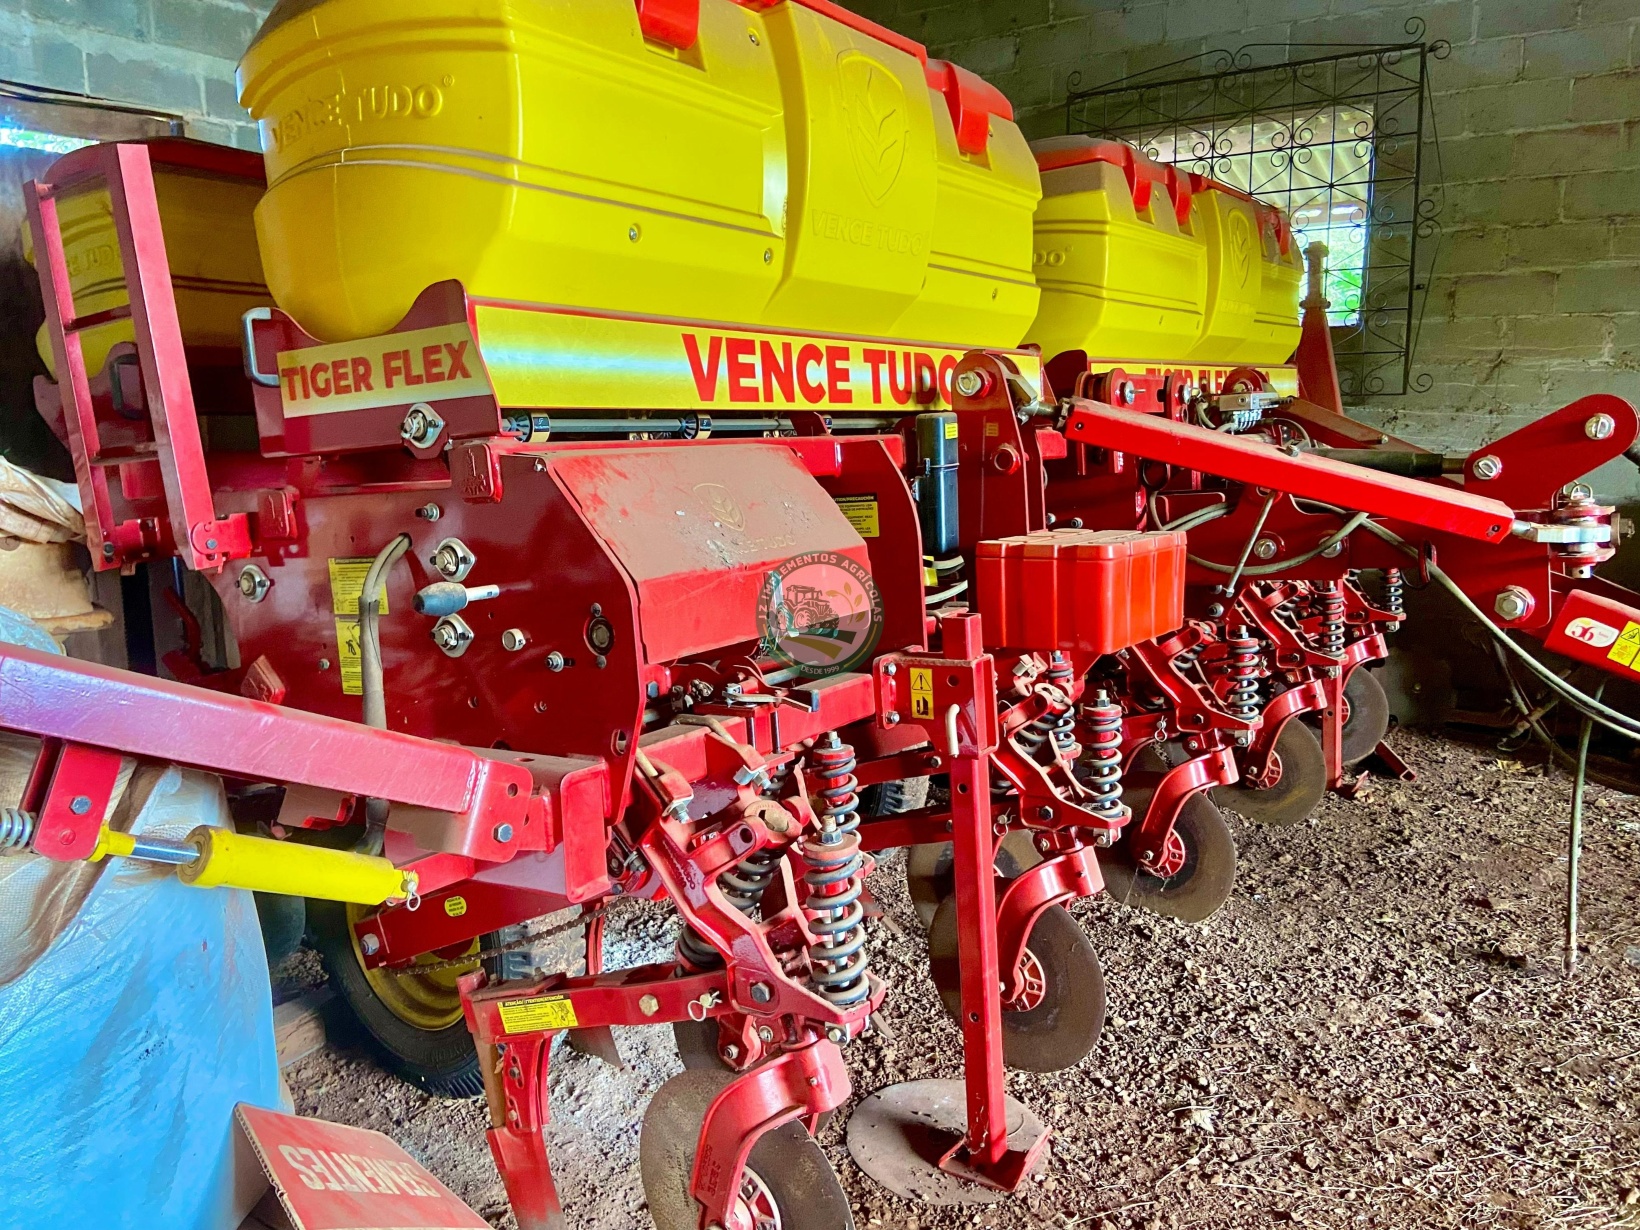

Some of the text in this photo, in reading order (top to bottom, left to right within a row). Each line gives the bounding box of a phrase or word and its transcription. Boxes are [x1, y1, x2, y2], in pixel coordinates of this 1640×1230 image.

[811, 208, 875, 247] VENCE
[281, 340, 473, 402] TIGER FLEX
[681, 333, 853, 404] VENCE
[277, 1144, 442, 1198] SEMENTES
